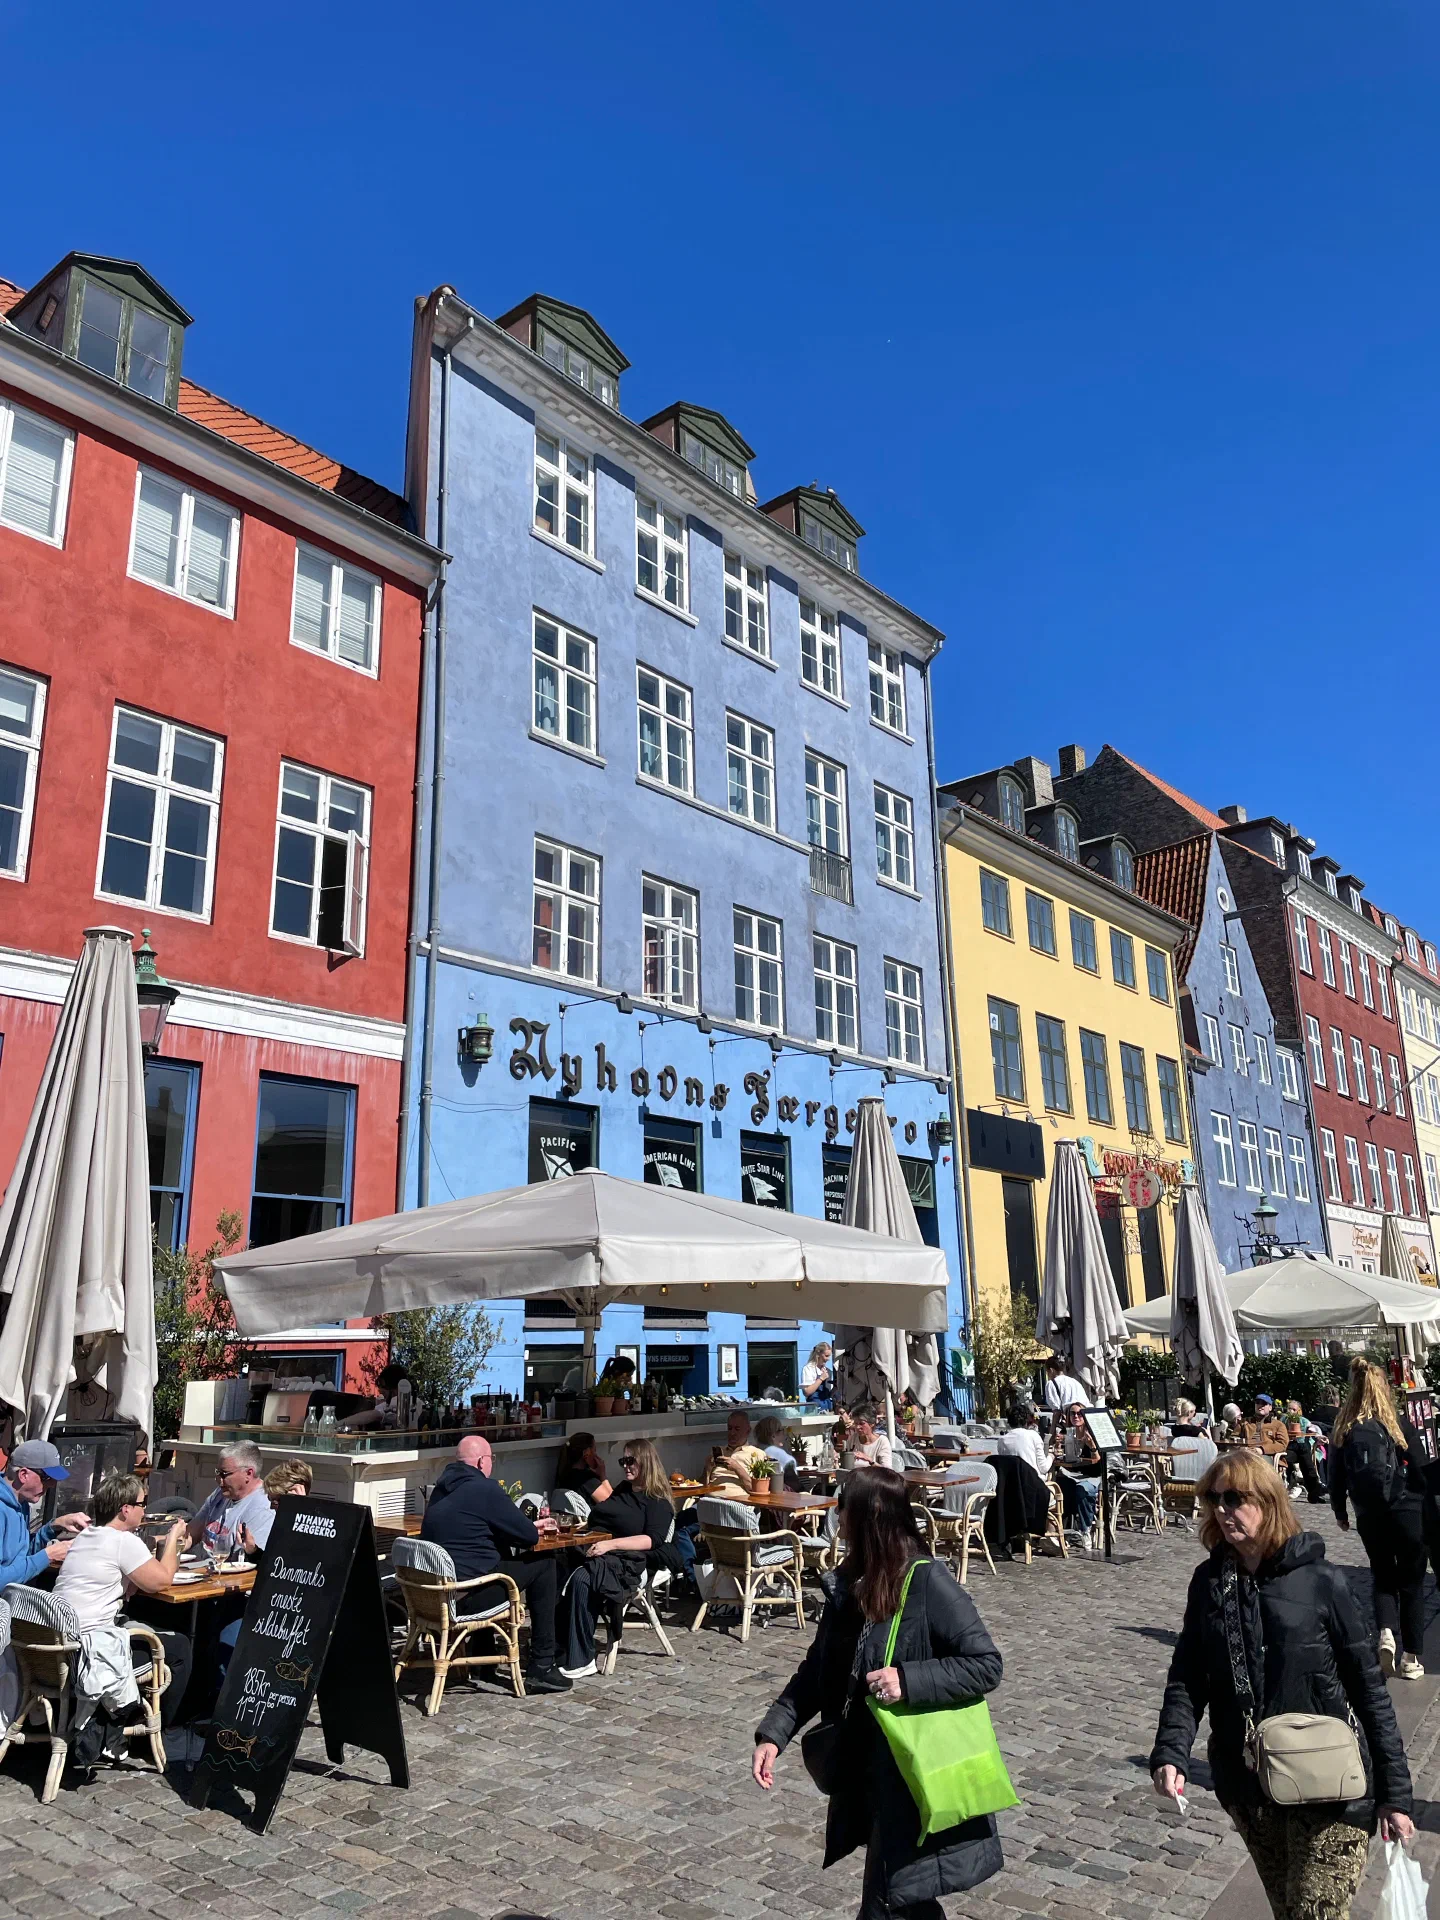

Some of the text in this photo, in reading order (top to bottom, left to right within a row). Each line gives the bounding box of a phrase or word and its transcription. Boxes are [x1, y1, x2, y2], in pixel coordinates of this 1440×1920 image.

[509, 1017, 917, 1145] Nyhavns Færgero
[540, 1136, 577, 1151] PACIFIC
[675, 1331, 682, 1342] 5
[295, 1513, 335, 1528] NYHAVNS
[292, 1521, 337, 1538] FÆRGEKRO
[270, 1556, 325, 1587] Danmarks
[251, 1610, 312, 1658] sildebuffet
